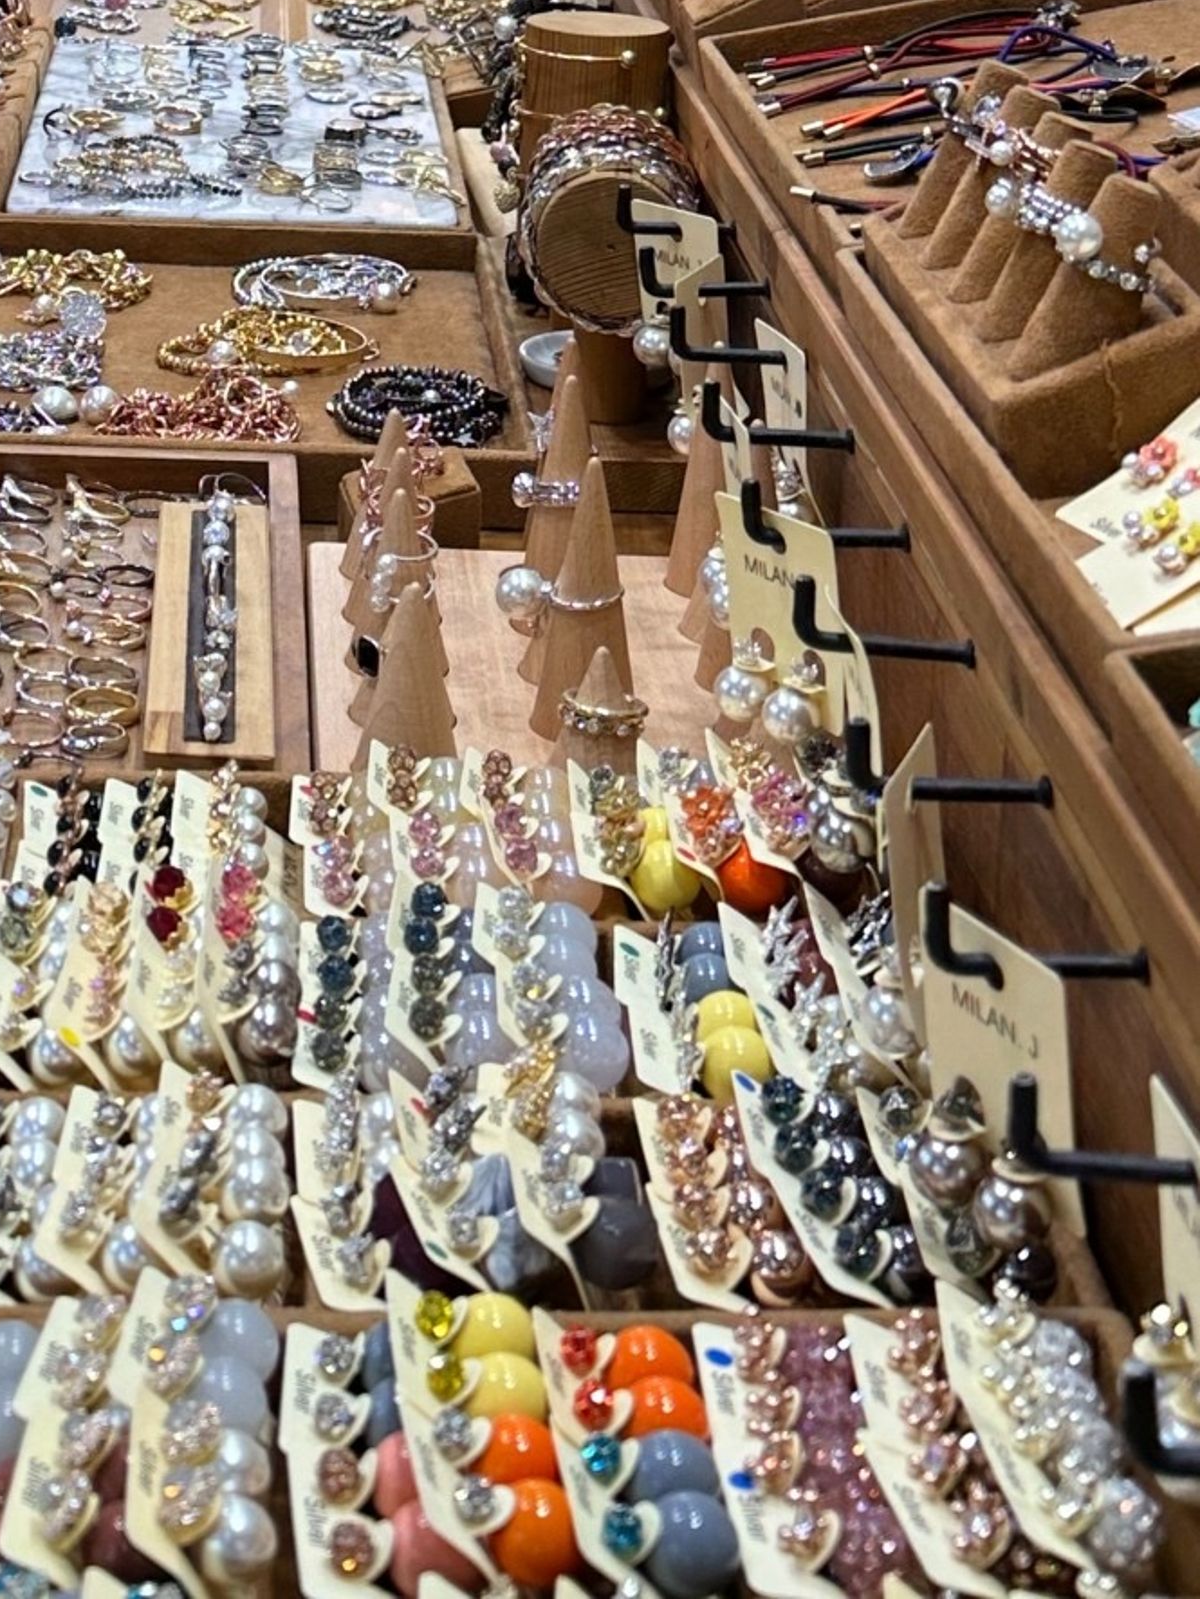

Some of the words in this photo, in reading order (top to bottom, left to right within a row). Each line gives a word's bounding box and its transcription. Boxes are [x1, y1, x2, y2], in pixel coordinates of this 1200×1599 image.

[1028, 1034, 1039, 1060] J
[711, 1370, 736, 1417] Silver
[305, 1495, 330, 1550] Silver
